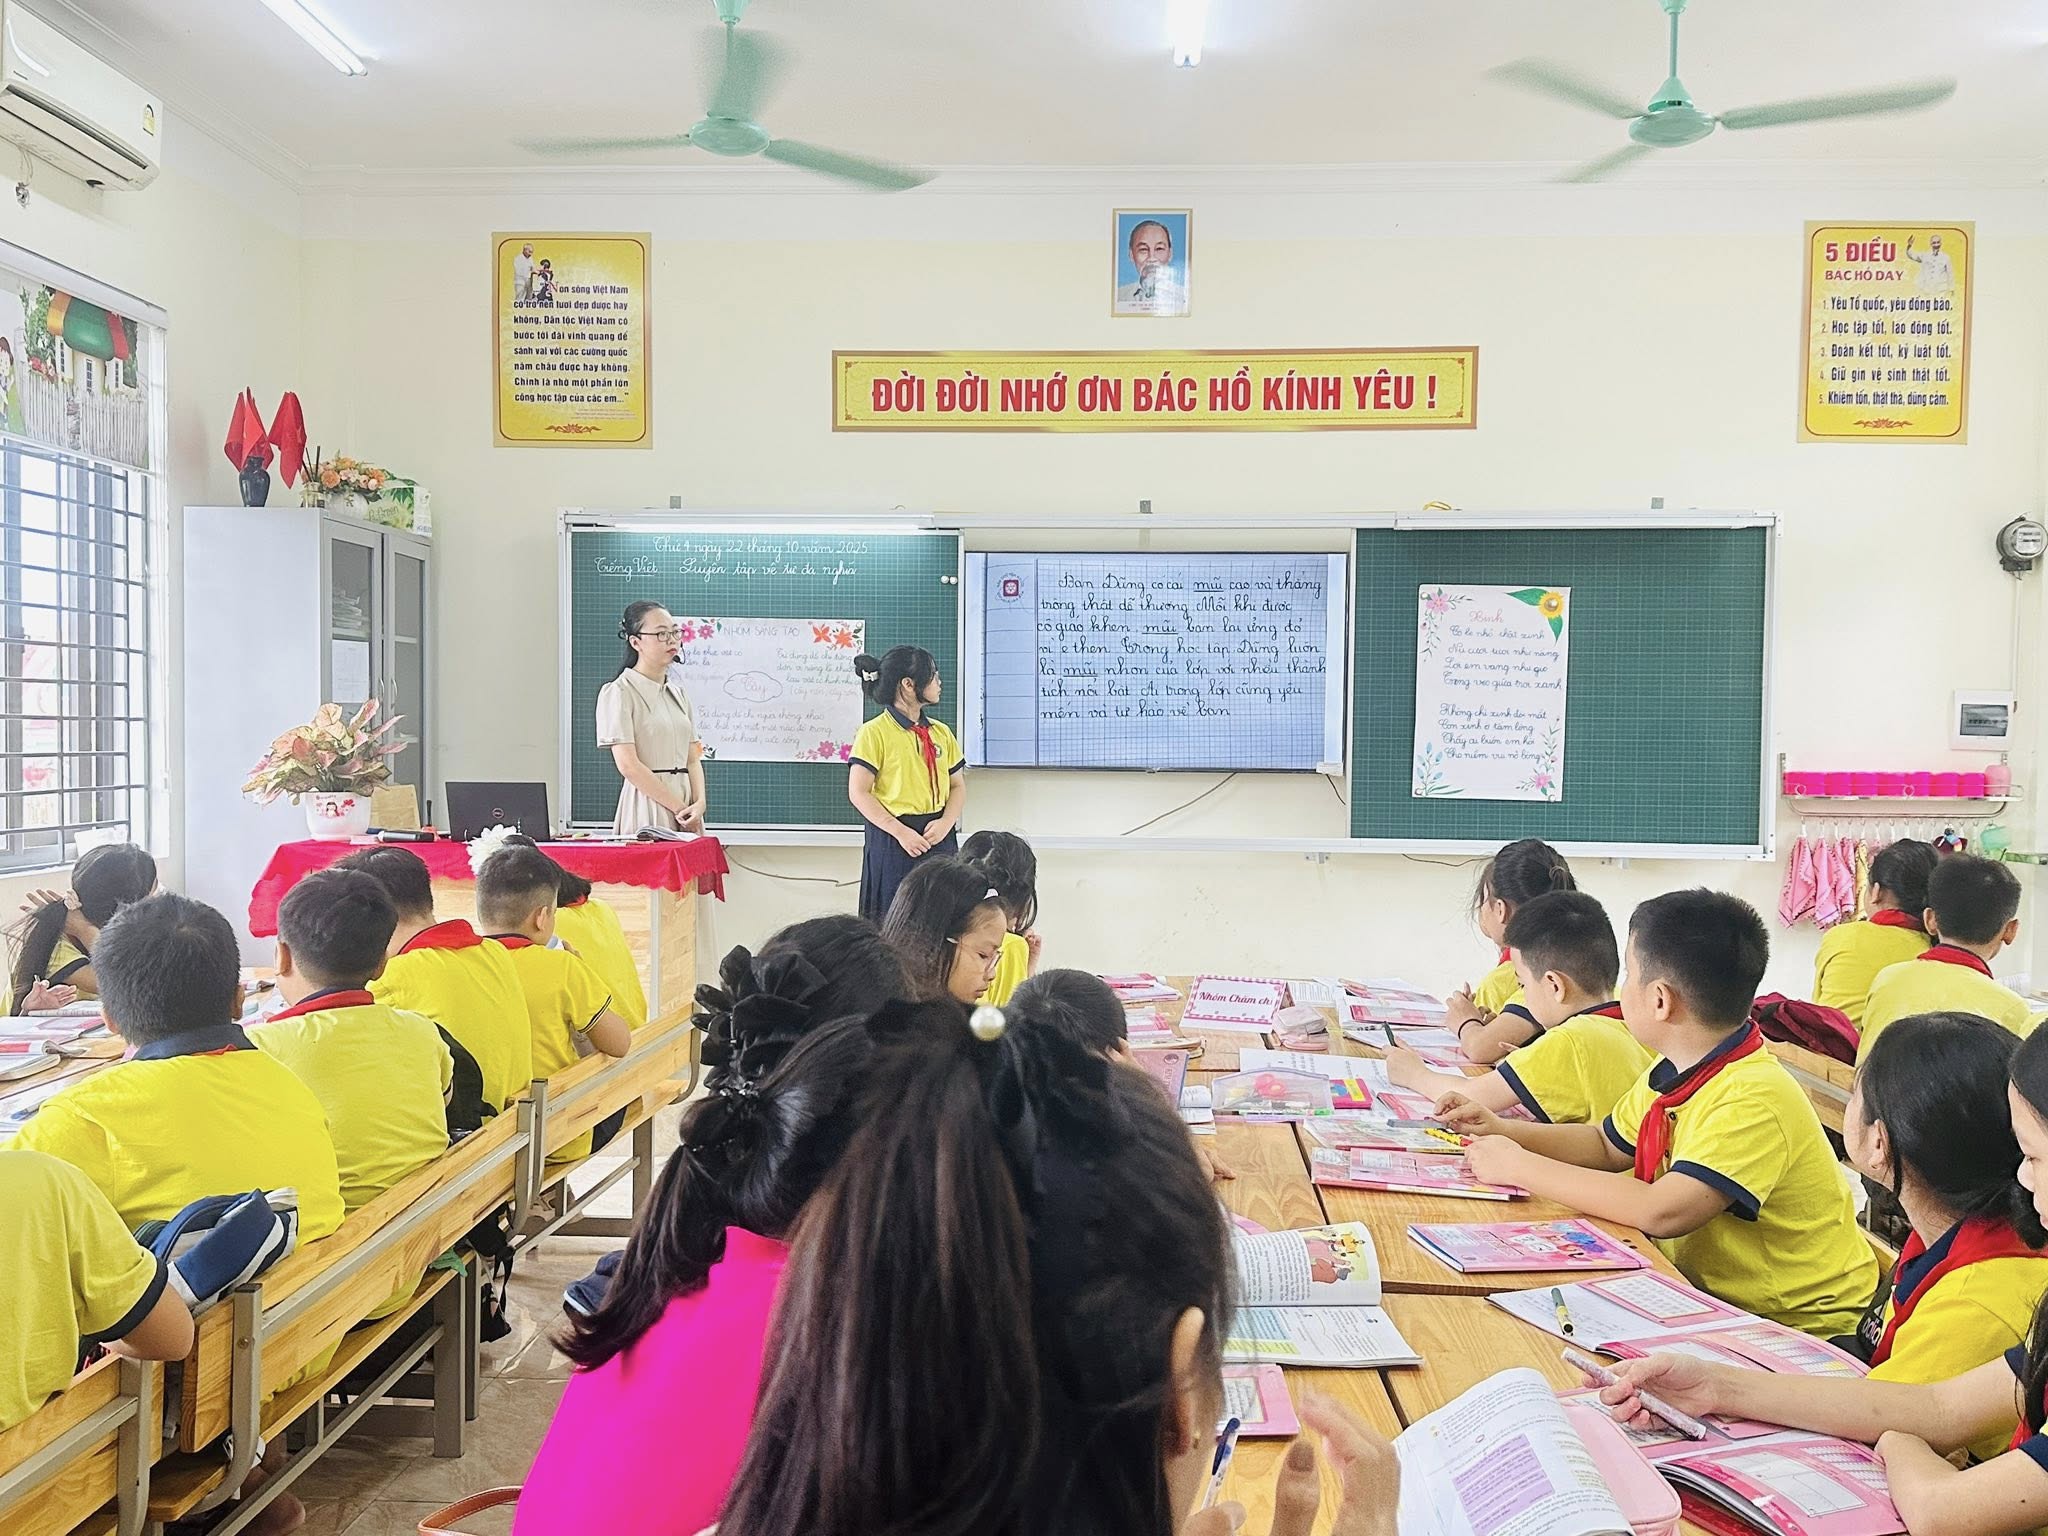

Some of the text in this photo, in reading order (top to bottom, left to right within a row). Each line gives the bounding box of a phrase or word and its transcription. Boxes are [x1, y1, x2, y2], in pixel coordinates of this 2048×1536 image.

[1826, 236, 1896, 262] 5 ĐIỀU
[593, 285, 608, 294] Việt
[610, 285, 628, 294] Nam
[614, 302, 627, 310] hay
[1831, 297, 1847, 310] Yêu
[1890, 297, 1905, 312] yêu
[578, 316, 594, 326] Việt
[1832, 320, 1849, 336] Học
[1892, 320, 1905, 334] lao
[568, 332, 586, 340] vinh
[589, 333, 615, 341] quang
[536, 347, 547, 355] vai
[583, 363, 598, 372] hay
[1887, 368, 1906, 381] sinh
[872, 365, 1437, 413] ĐỜI ĐỜI NHỚ ƠN BÁC HỒ KÍNH YÊU !
[727, 540, 743, 552] 22
[748, 536, 782, 563] tháng
[786, 541, 798, 553] 10
[837, 541, 868, 554] 2025
[1102, 573, 1144, 599] Dũng
[1230, 581, 1250, 589] cao
[1255, 576, 1272, 589] và
[1196, 596, 1227, 611] Mỗi
[1234, 594, 1257, 611] khi
[1237, 639, 1279, 663] Dũng
[1287, 656, 1326, 673] thành
[1236, 682, 1272, 704] cũng
